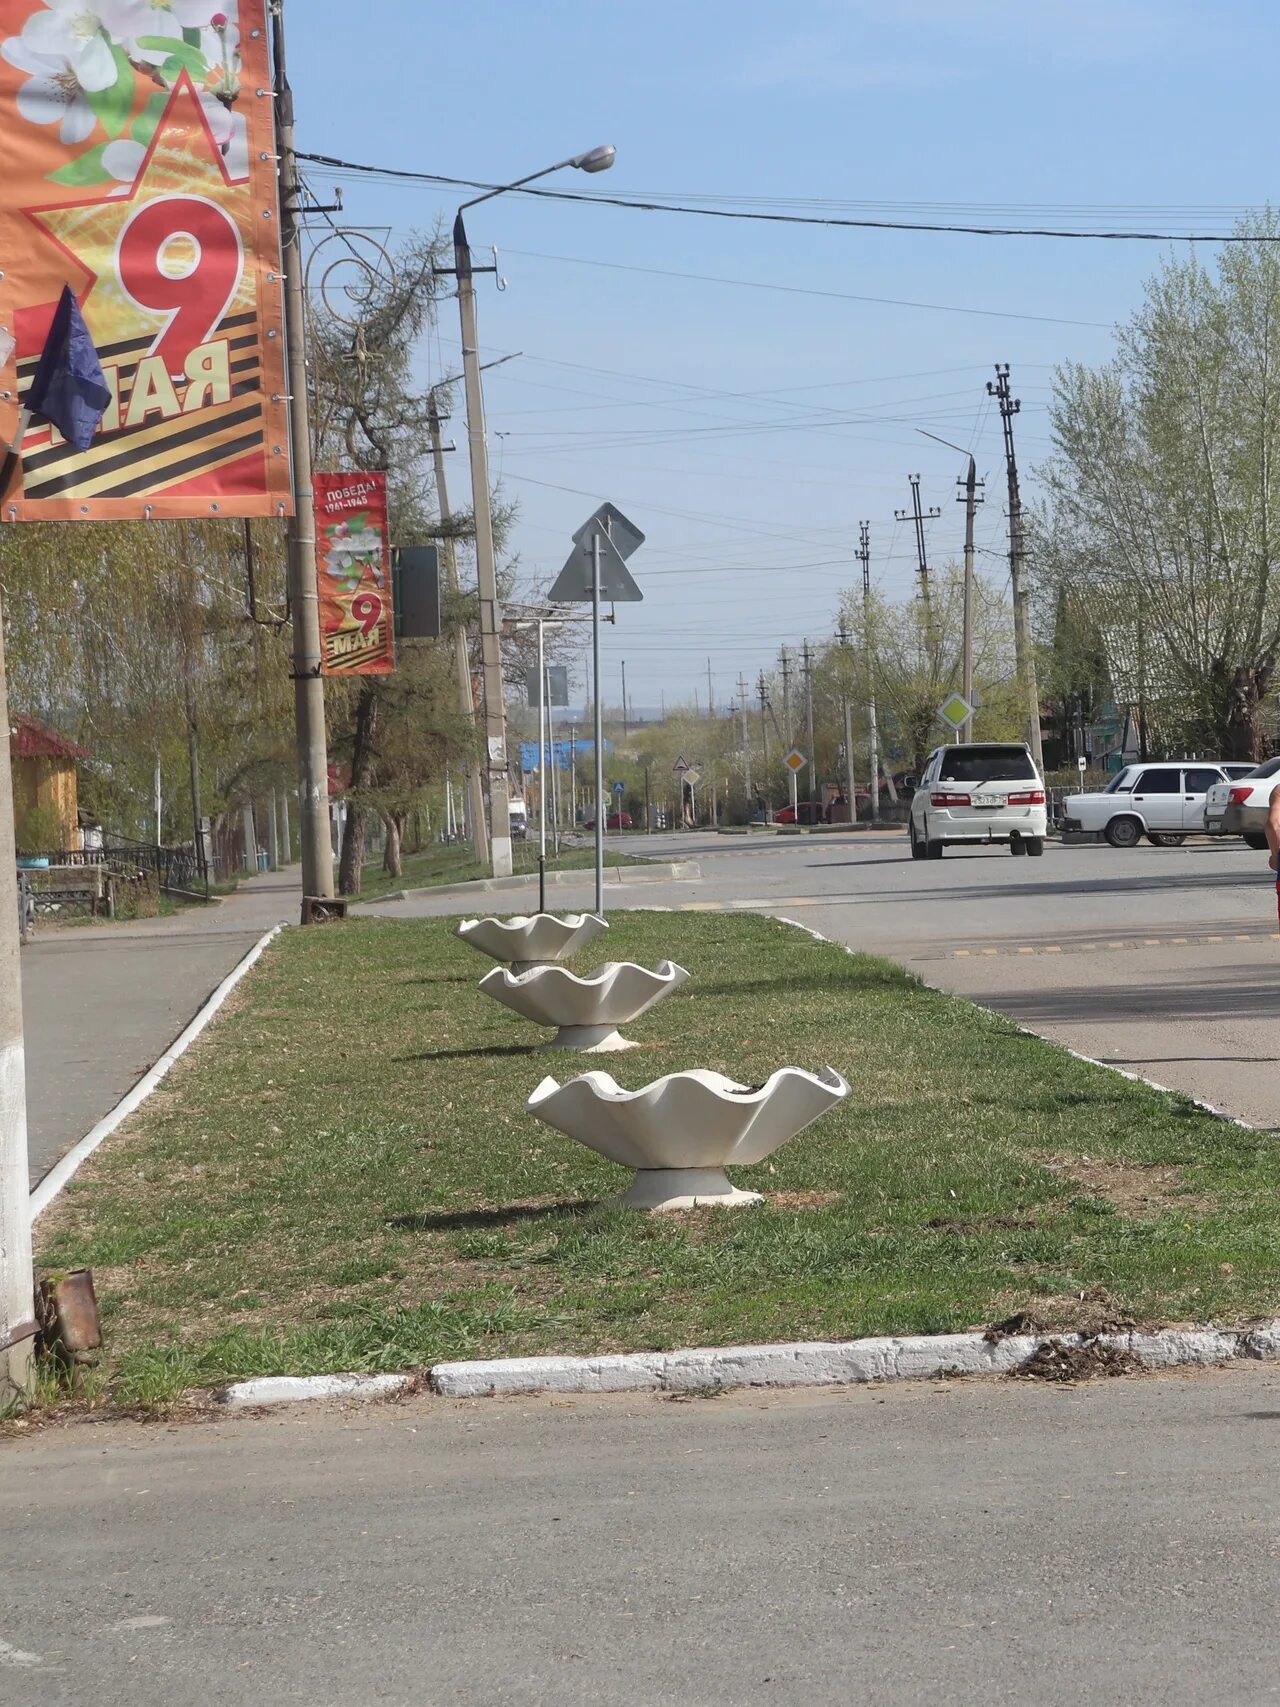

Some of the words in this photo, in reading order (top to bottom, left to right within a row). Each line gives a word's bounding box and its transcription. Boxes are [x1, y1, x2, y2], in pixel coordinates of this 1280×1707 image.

[115, 194, 245, 380] 9
[326, 480, 377, 502] ПОБЕДА!
[351, 592, 383, 637] 9
[333, 628, 380, 655] МАЯ
